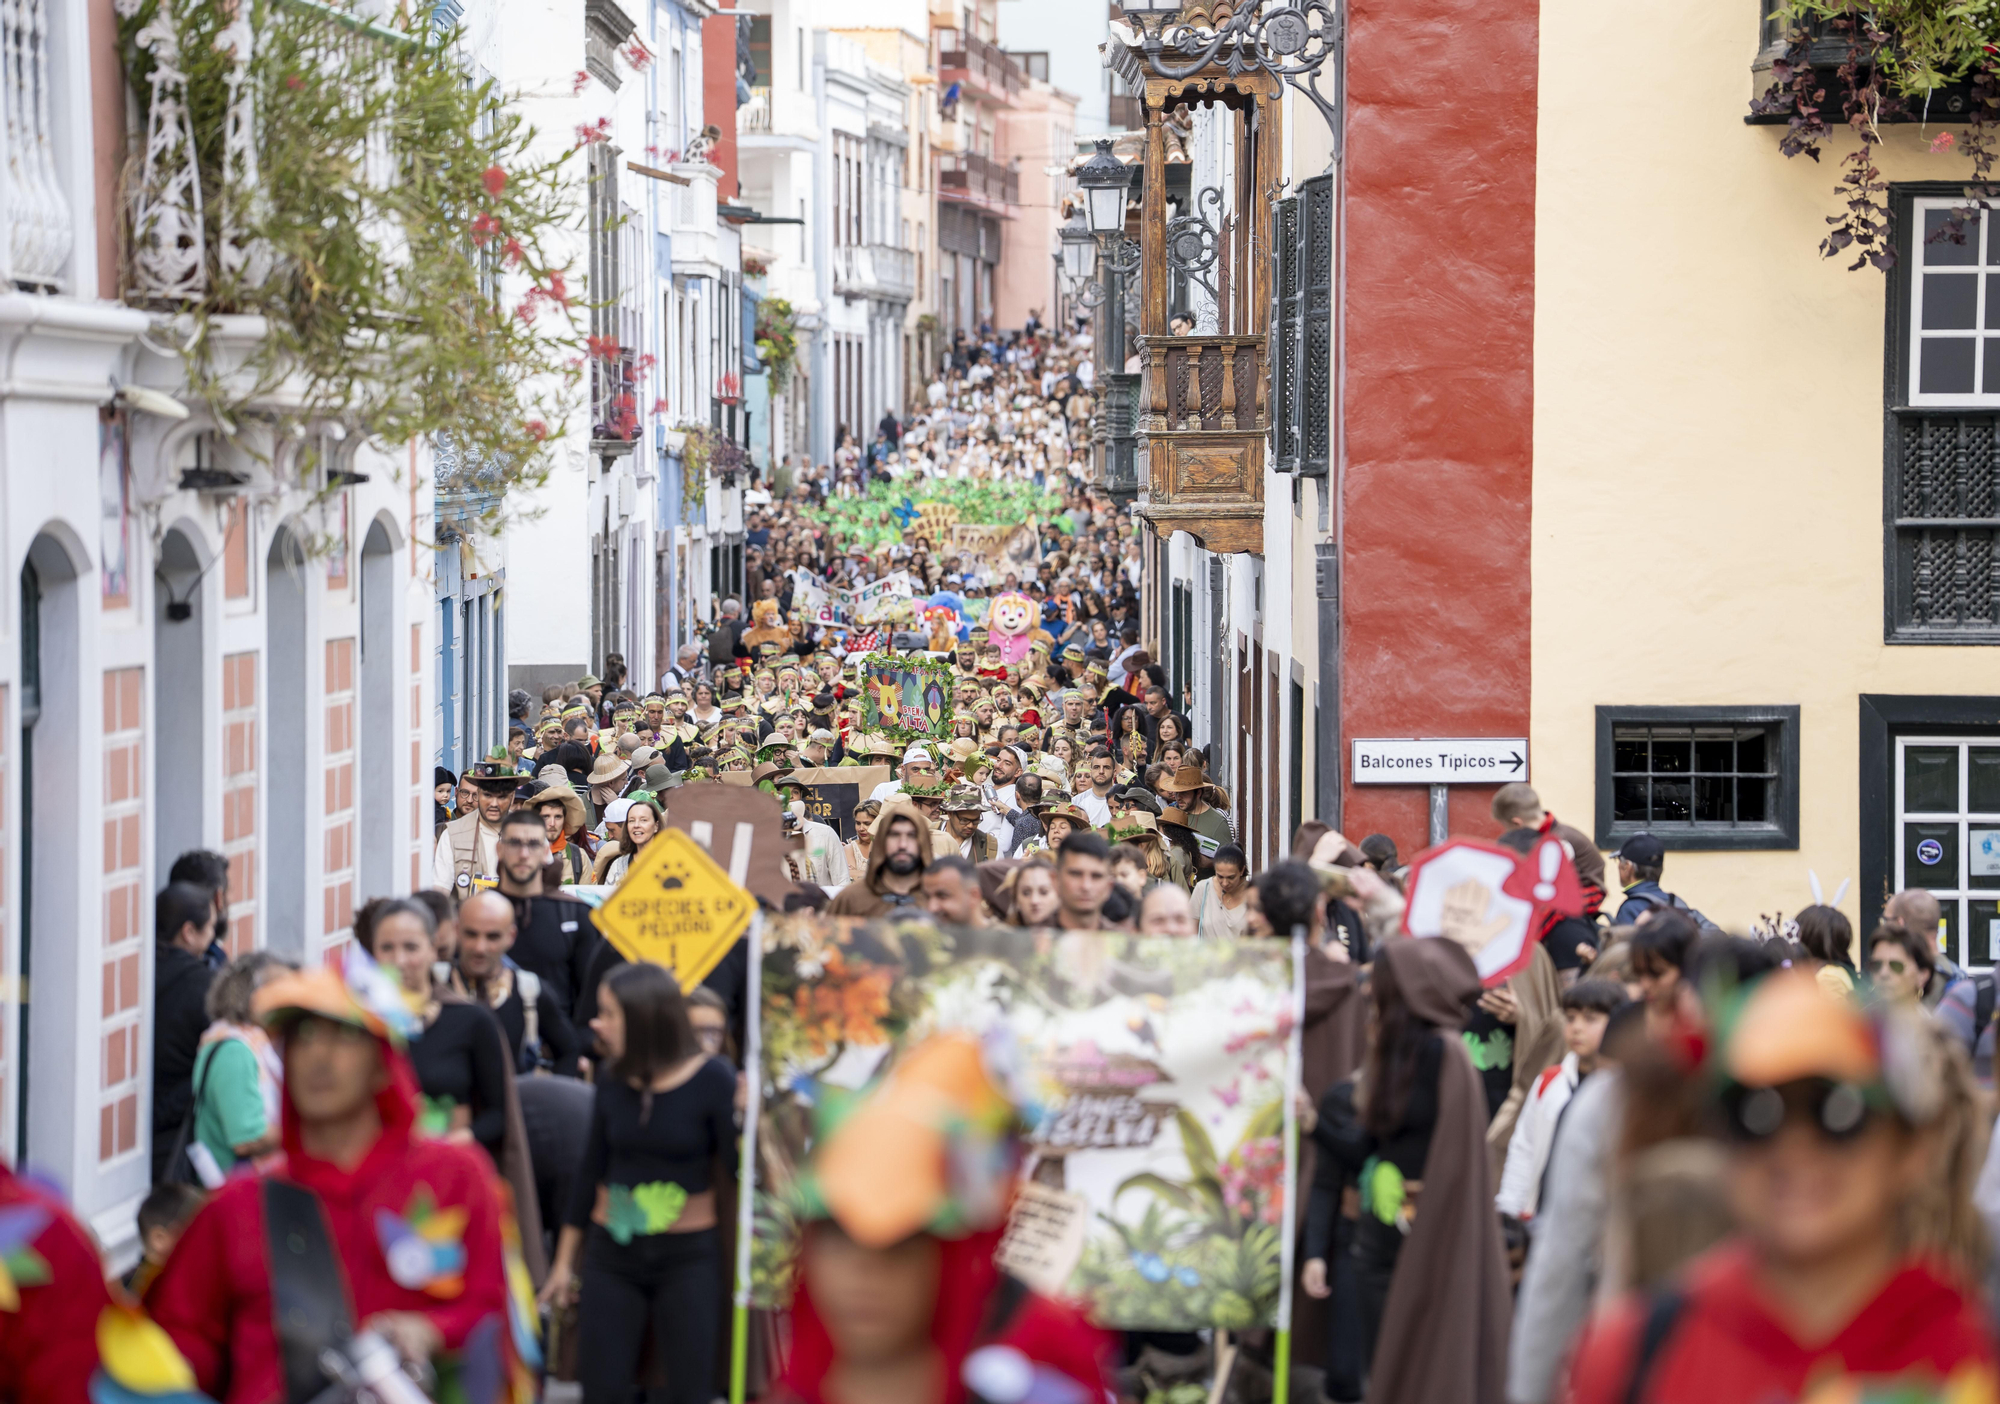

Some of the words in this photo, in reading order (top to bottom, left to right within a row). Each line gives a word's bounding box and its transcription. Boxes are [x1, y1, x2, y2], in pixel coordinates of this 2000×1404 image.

[811, 577, 892, 604] LUDOTECA
[902, 705, 925, 718] BREÑA
[898, 716, 930, 732] ALTA
[1361, 754, 1433, 768] Balcones
[1439, 753, 1496, 771] Típicos
[620, 900, 706, 920] ESPECIES
